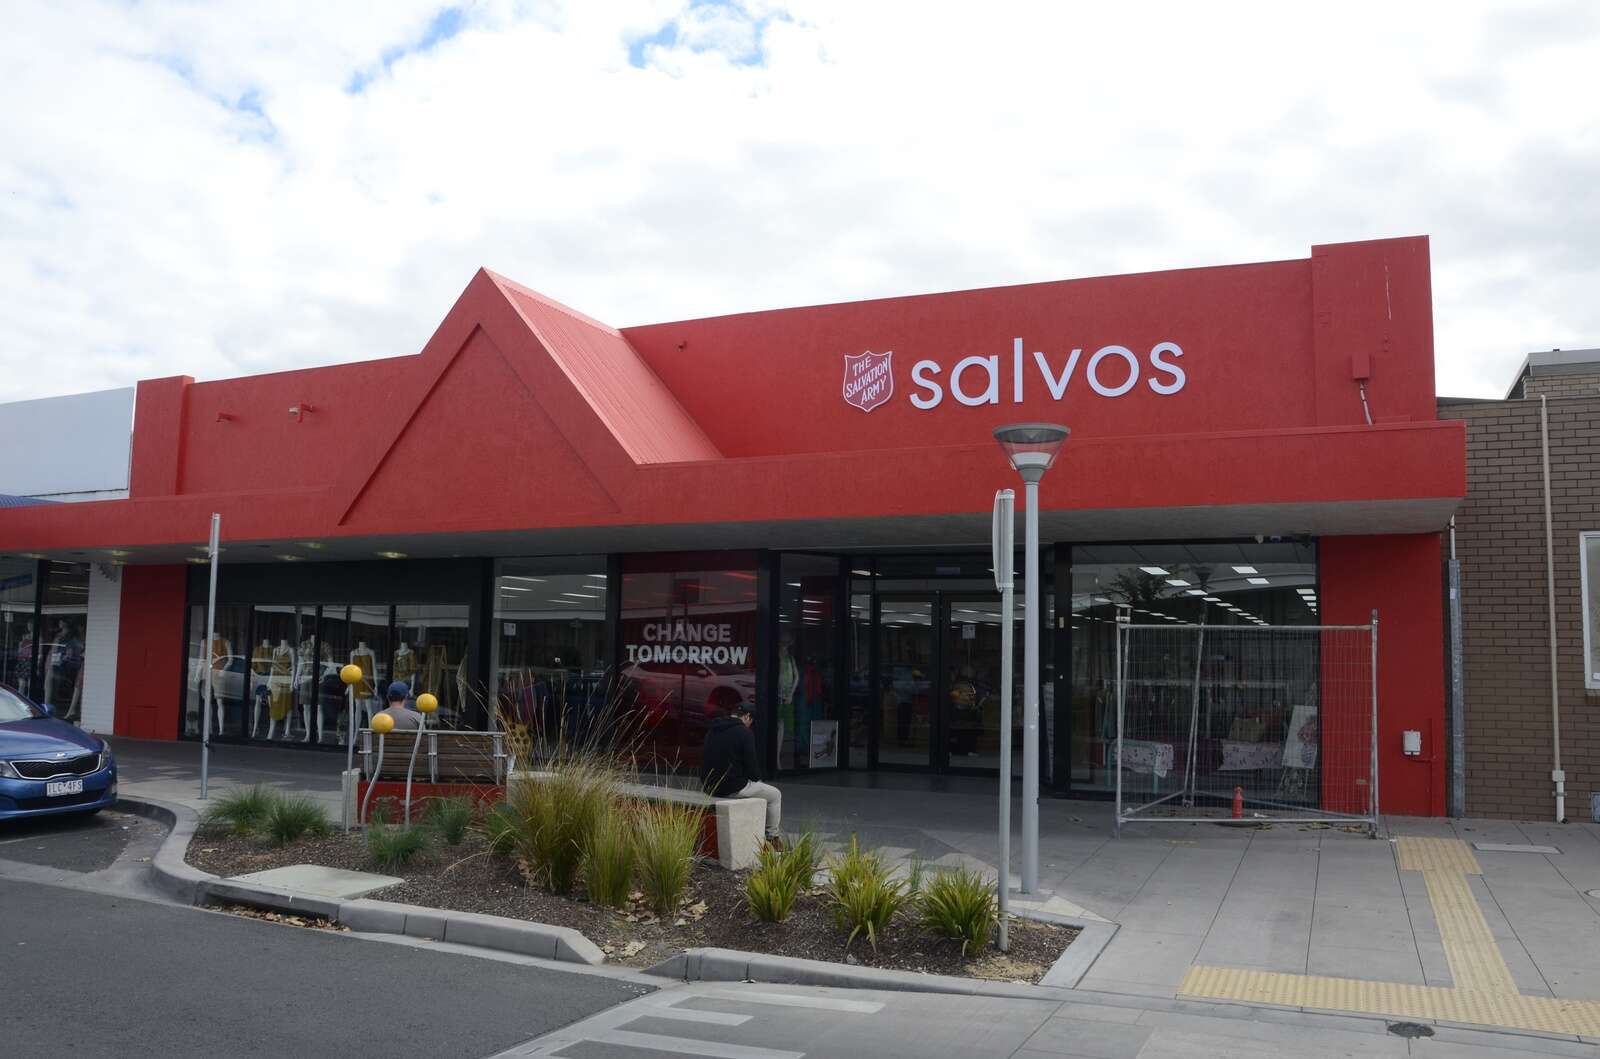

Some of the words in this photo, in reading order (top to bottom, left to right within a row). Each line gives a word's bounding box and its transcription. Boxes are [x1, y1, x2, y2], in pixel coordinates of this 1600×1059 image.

[846, 357, 888, 398] SALVATION
[853, 356, 871, 377] THE
[909, 337, 1186, 410] salvos
[860, 375, 887, 405] ARMY
[642, 623, 732, 642] CHANGE
[625, 644, 749, 665] TOMORROW
